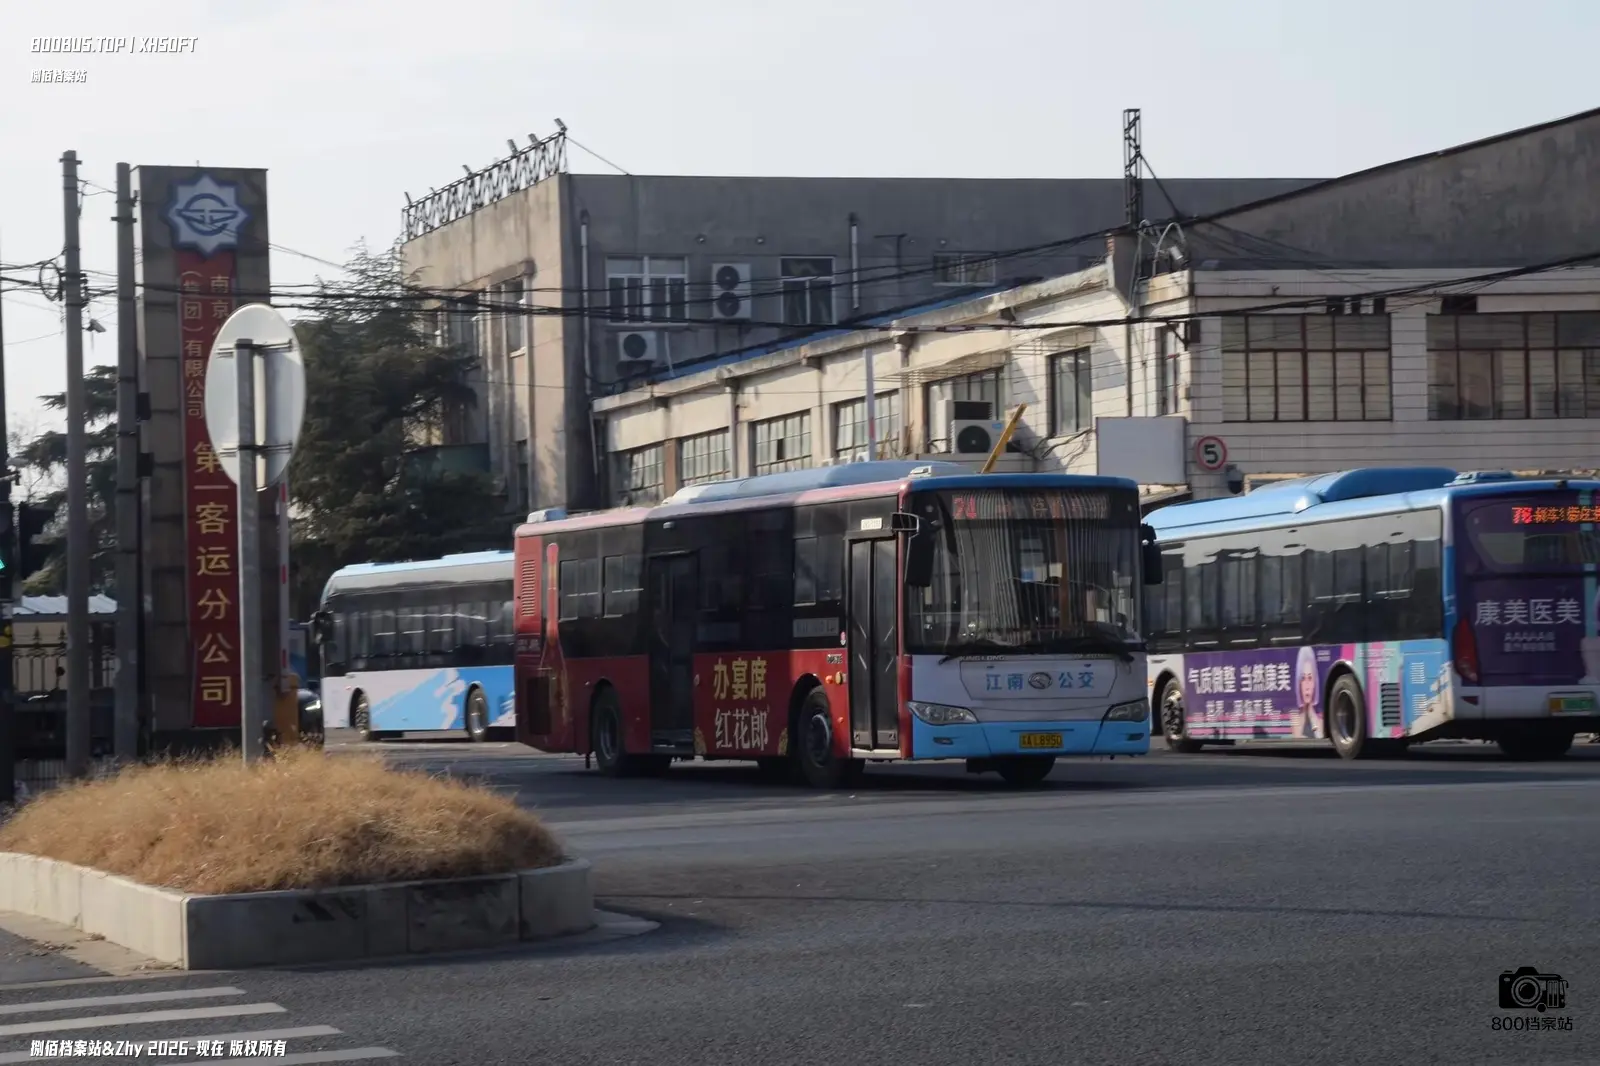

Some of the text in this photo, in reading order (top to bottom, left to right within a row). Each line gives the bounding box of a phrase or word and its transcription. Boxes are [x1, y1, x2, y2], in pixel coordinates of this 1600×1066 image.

[1203, 443, 1219, 465] 5
[193, 441, 232, 706] 第一客运分公司
[1475, 598, 1581, 626] 康美医美
[713, 656, 767, 700] 办宴席
[986, 670, 1095, 691] 江南 公交
[1240, 662, 1292, 692] 当然康美
[714, 706, 769, 751] 红花郎
